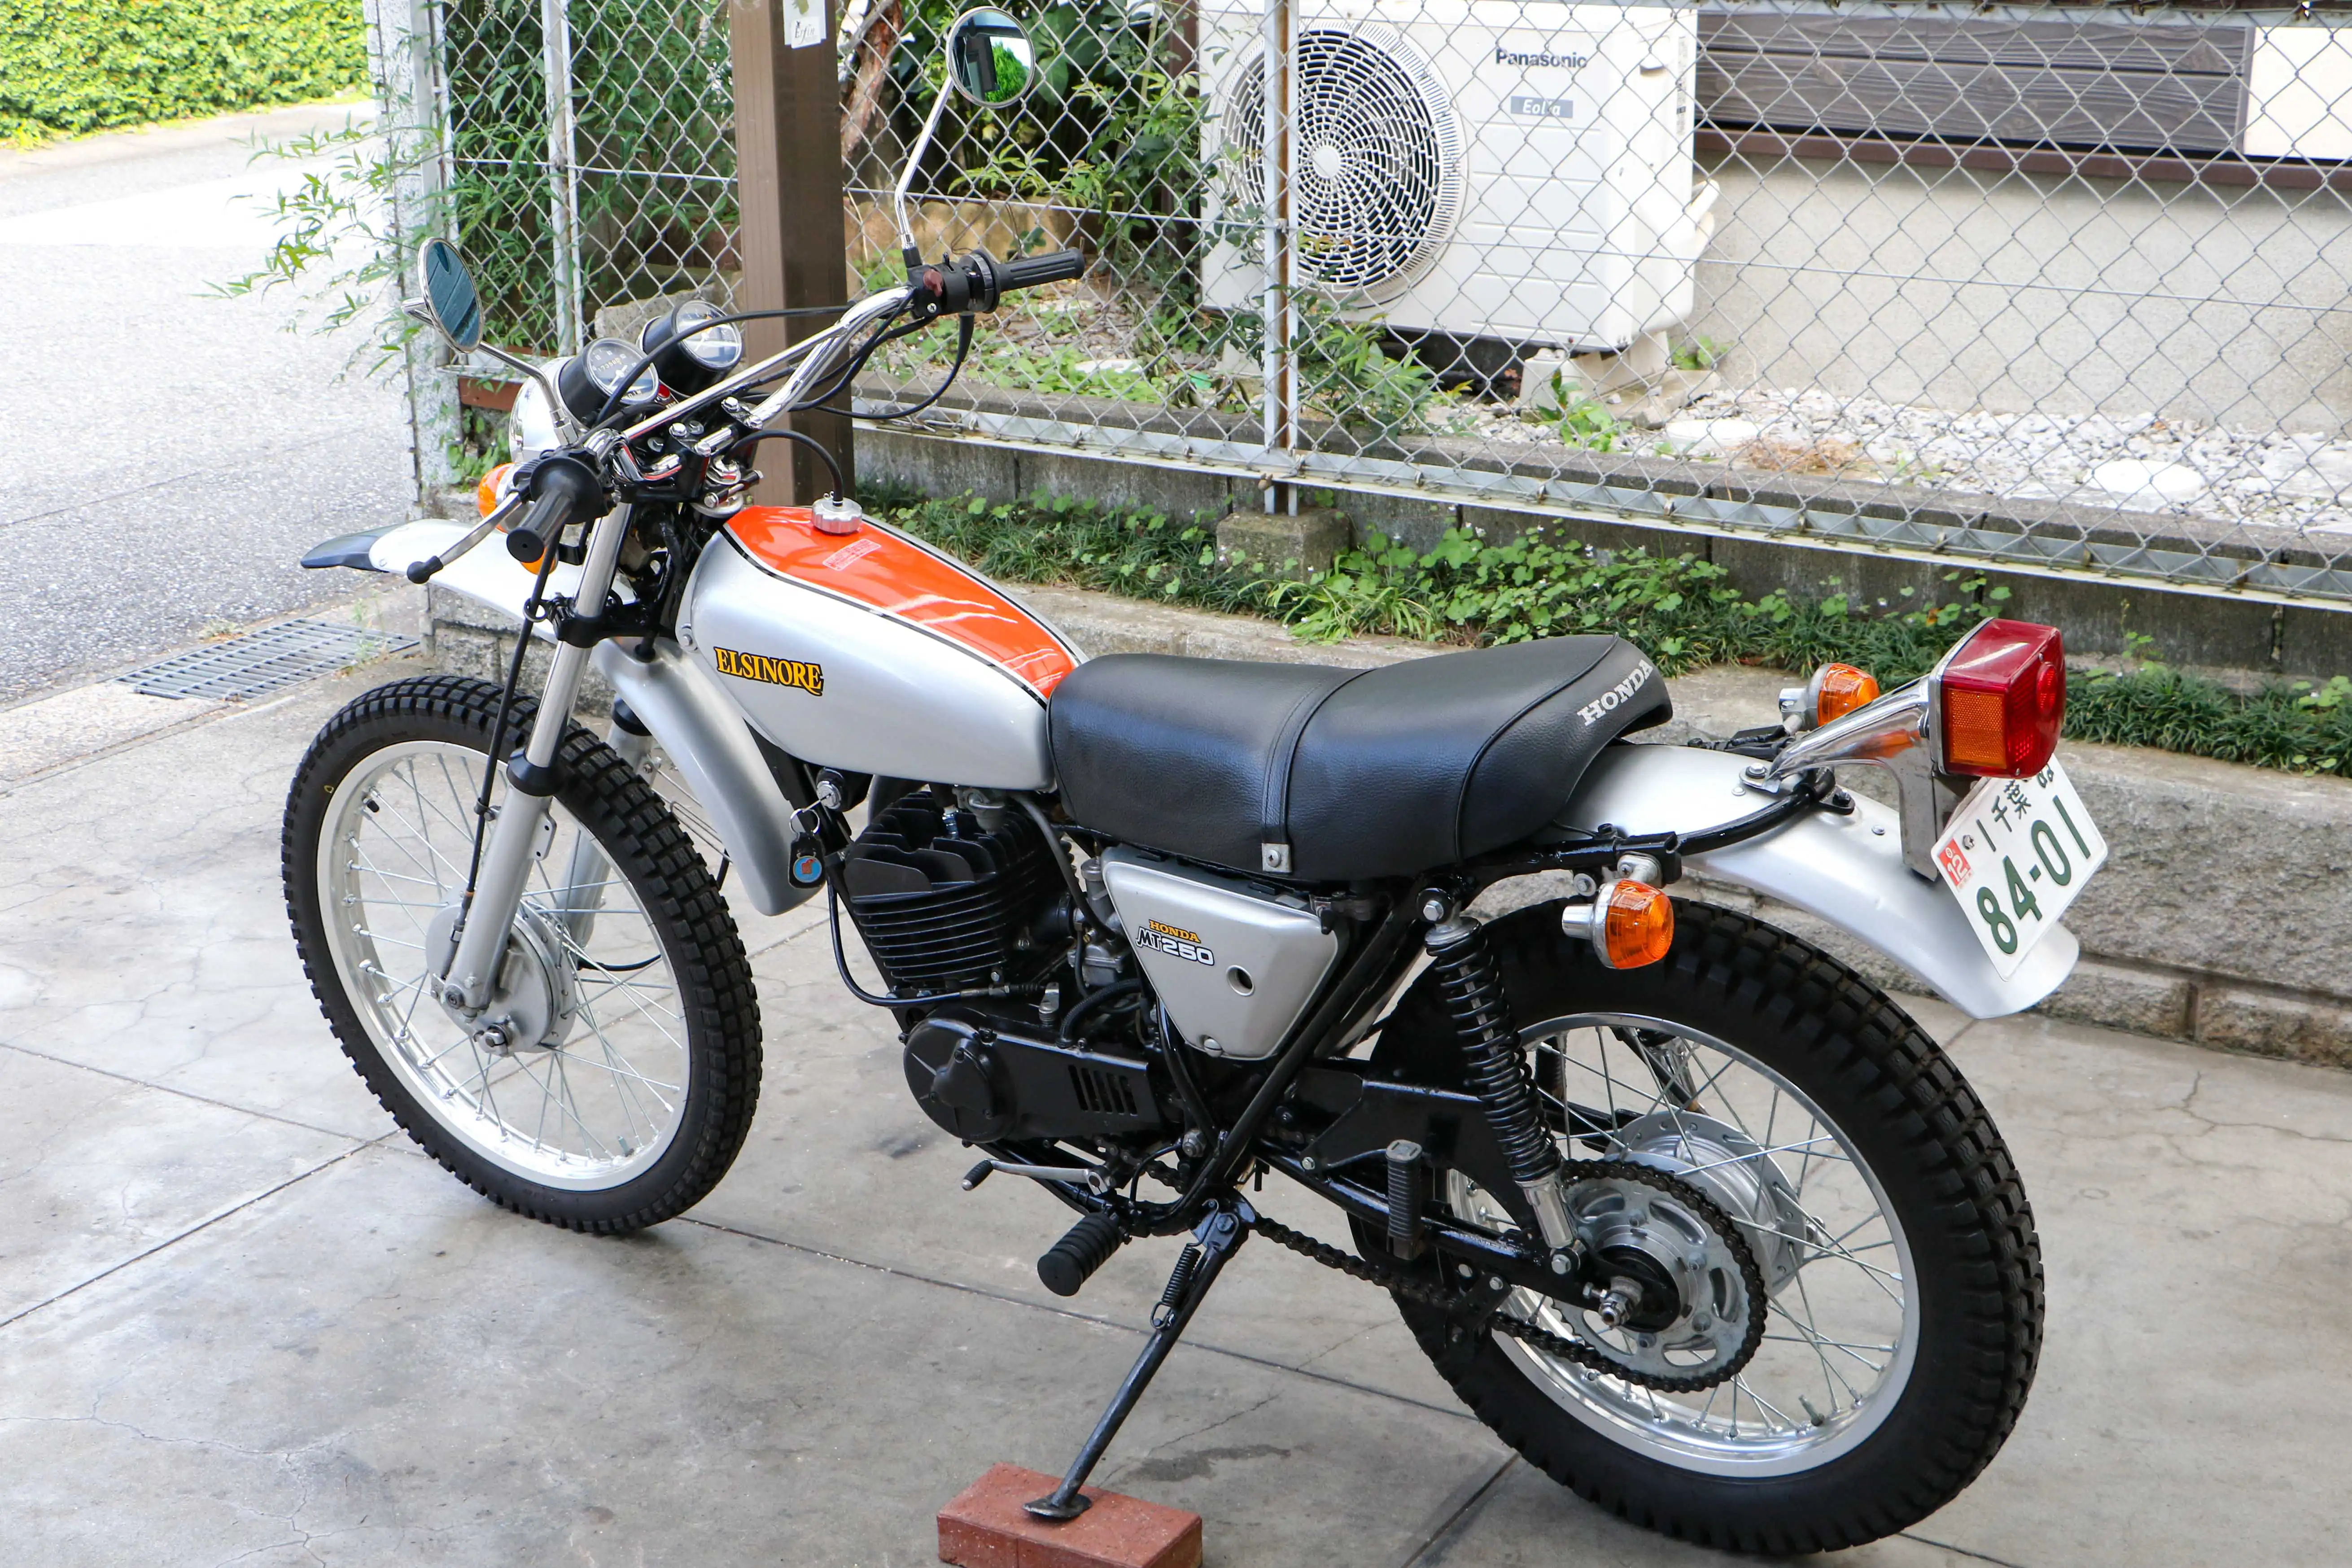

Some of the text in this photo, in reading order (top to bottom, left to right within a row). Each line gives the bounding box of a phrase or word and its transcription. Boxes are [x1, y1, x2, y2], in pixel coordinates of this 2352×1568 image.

[1496, 48, 1587, 68] Panasonic
[714, 646, 823, 696] ELSINORE
[1577, 659, 1653, 726] HONDA
[1991, 779, 2032, 833] 千葉
[1947, 854, 1968, 882] 12
[1976, 795, 2091, 955] 84-01
[1149, 919, 1201, 943] HONDA
